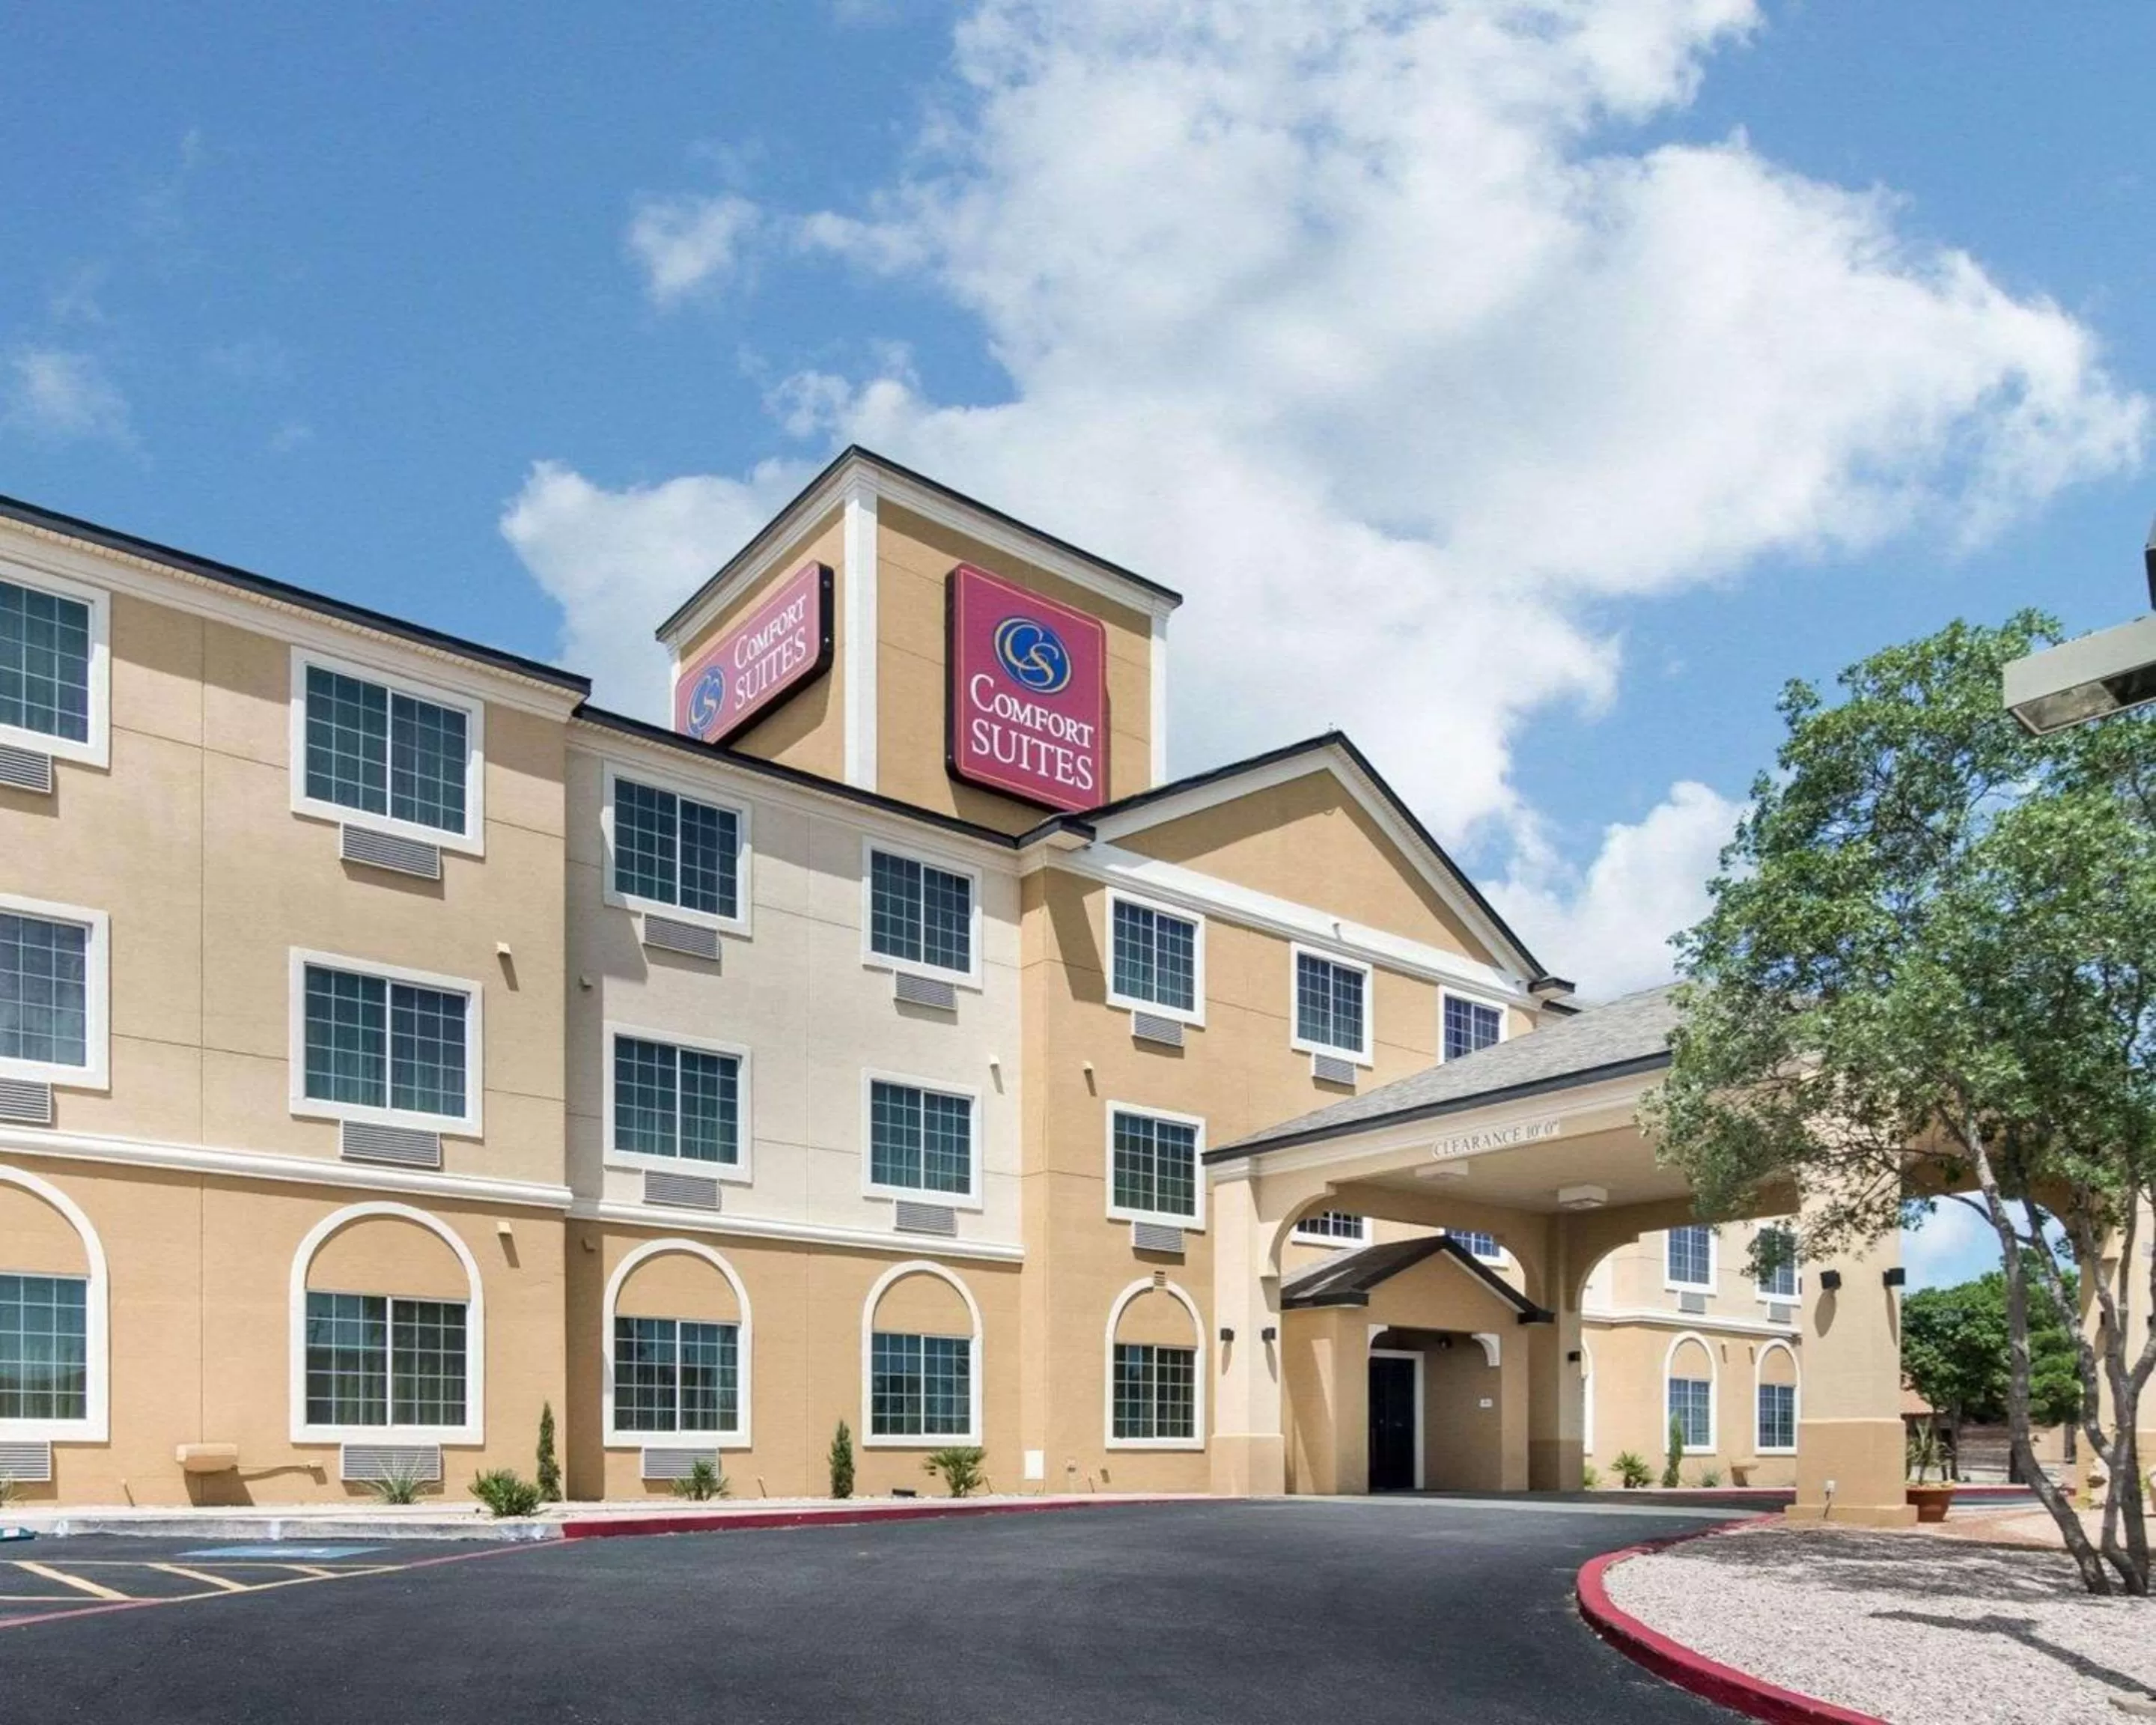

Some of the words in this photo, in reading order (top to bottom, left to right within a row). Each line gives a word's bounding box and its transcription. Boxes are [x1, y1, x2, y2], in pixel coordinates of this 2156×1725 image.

[735, 627, 806, 710] SUITES
[971, 719, 1093, 791] SUITES
[1434, 1127, 1520, 1155] CLEARANCE
